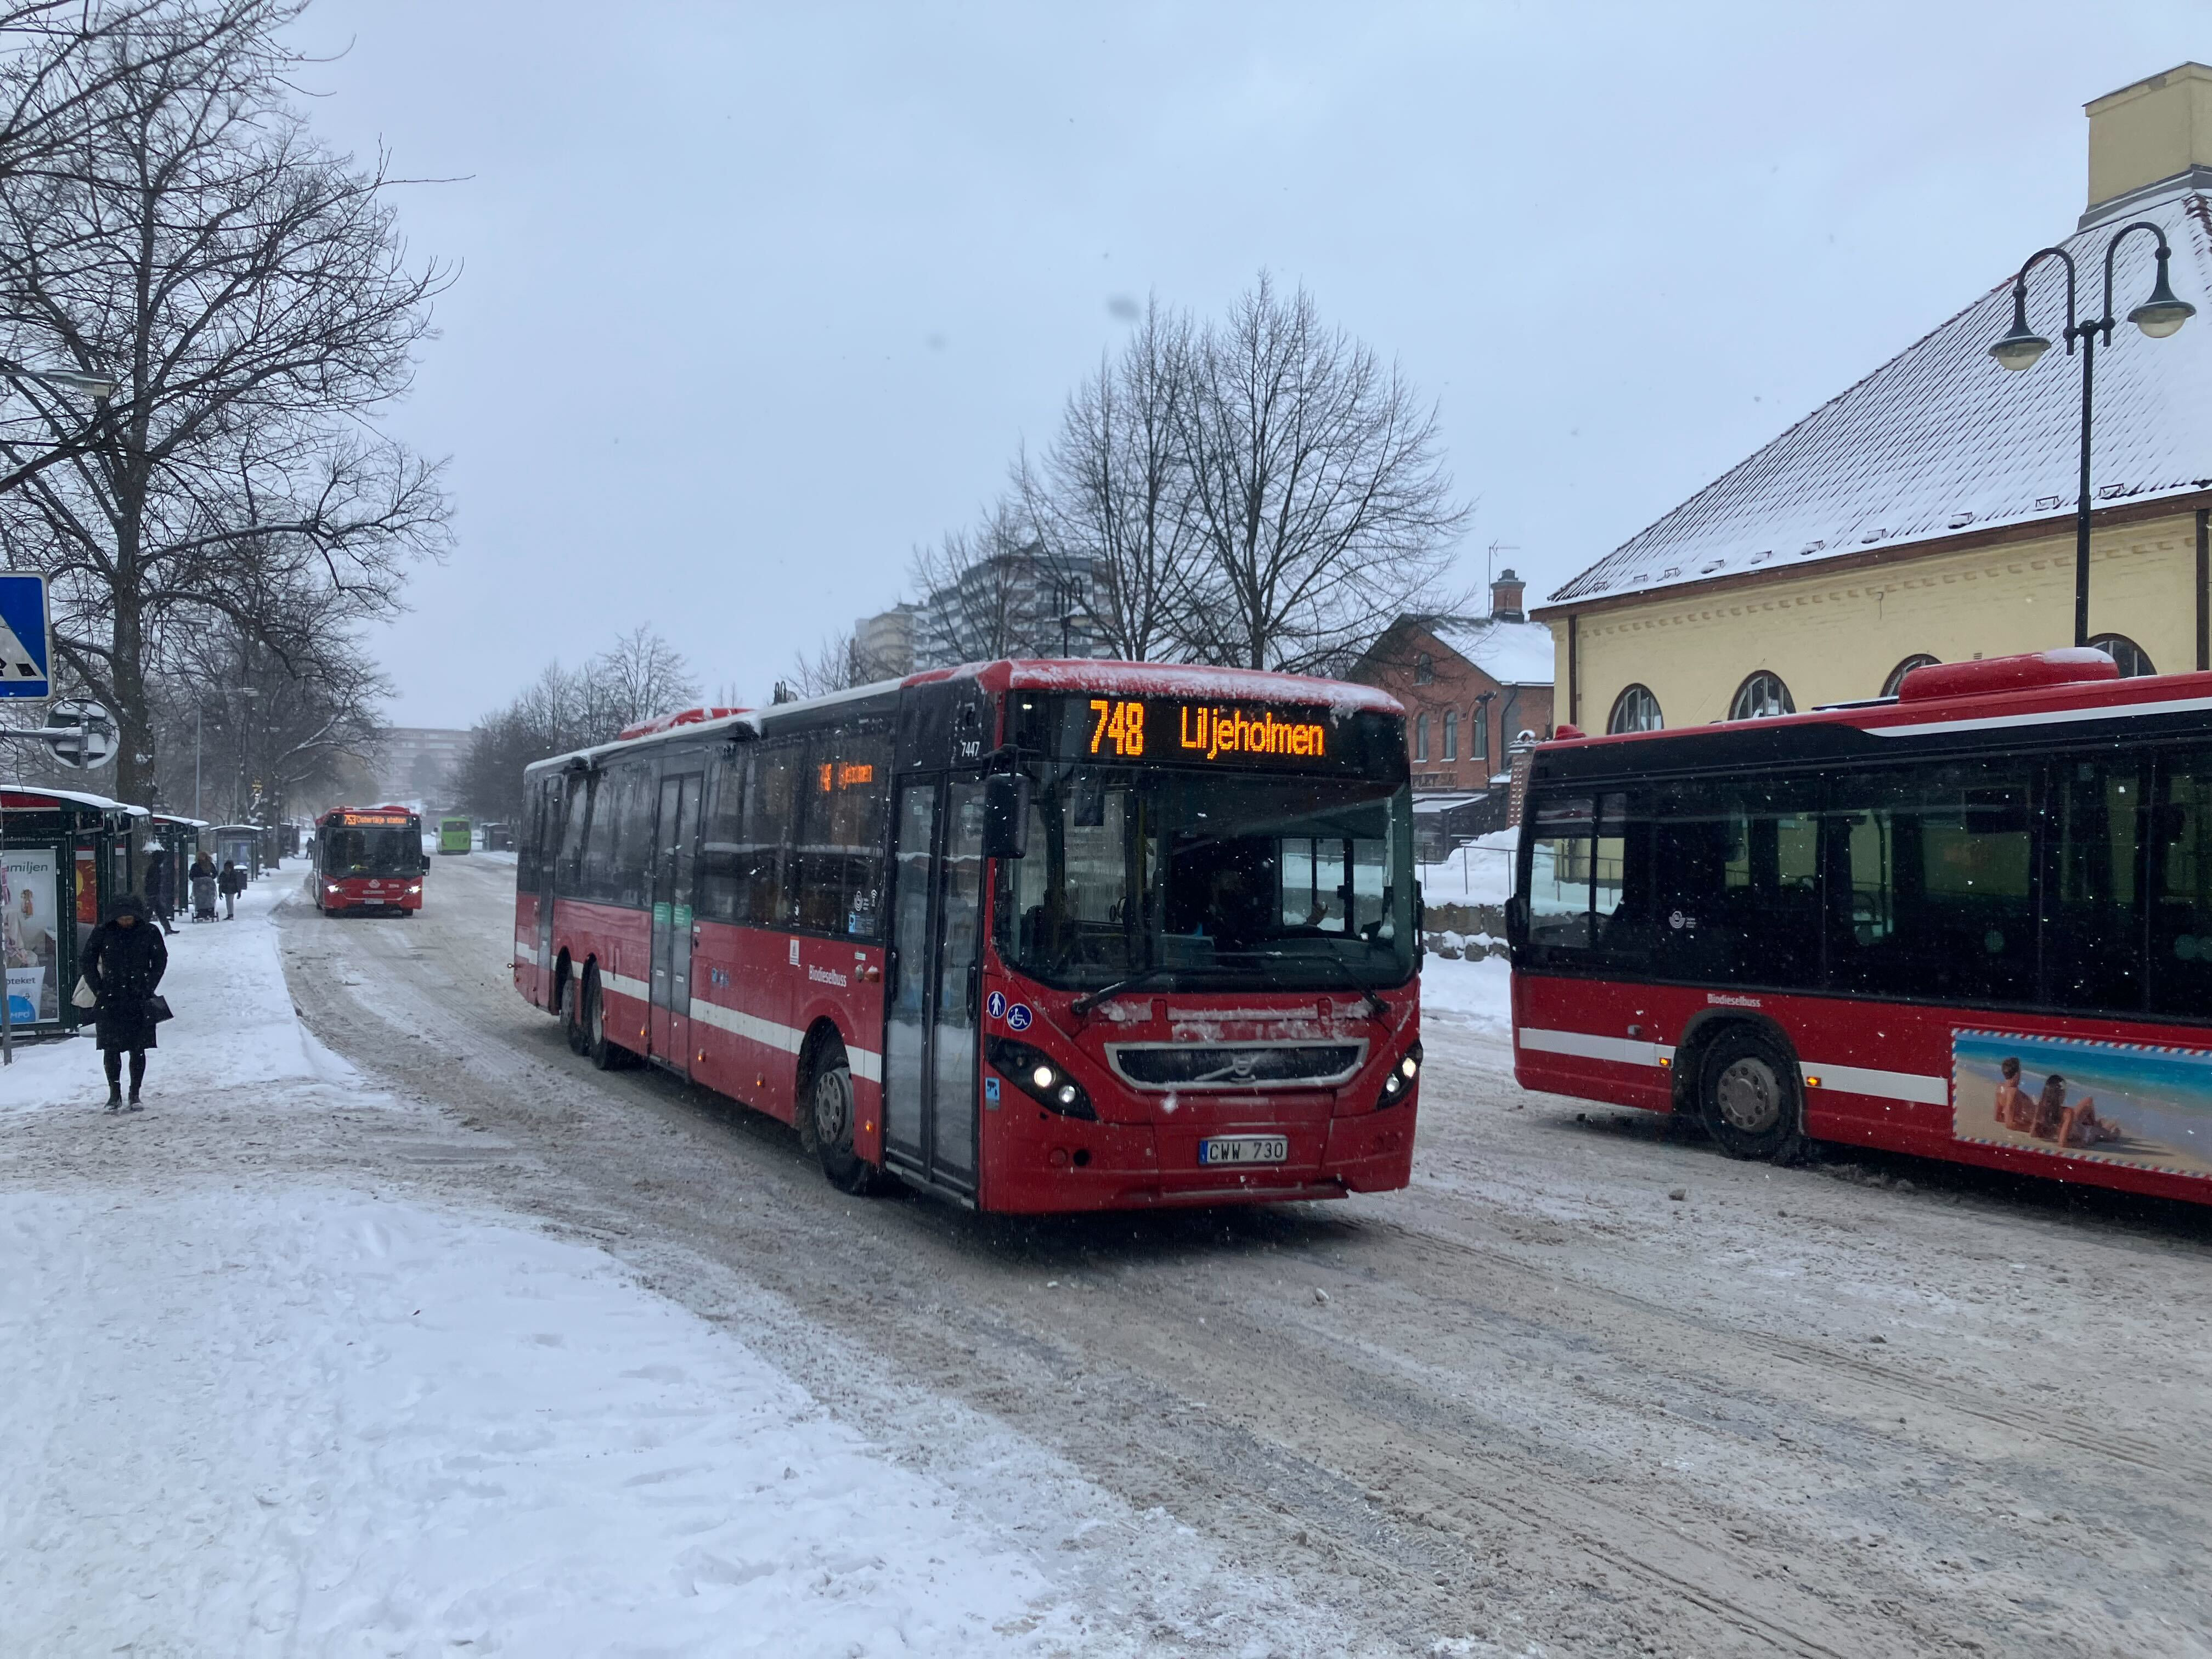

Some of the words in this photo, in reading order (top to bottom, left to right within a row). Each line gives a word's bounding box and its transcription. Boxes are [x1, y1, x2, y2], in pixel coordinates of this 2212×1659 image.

[1090, 699, 1144, 755] 748
[1181, 706, 1324, 760] Liljeholmen
[962, 741, 980, 757] 7447
[1707, 993, 1760, 1008] Biodieselbuss
[1210, 1143, 1240, 1160] CWW
[1254, 1142, 1283, 1159] 730
